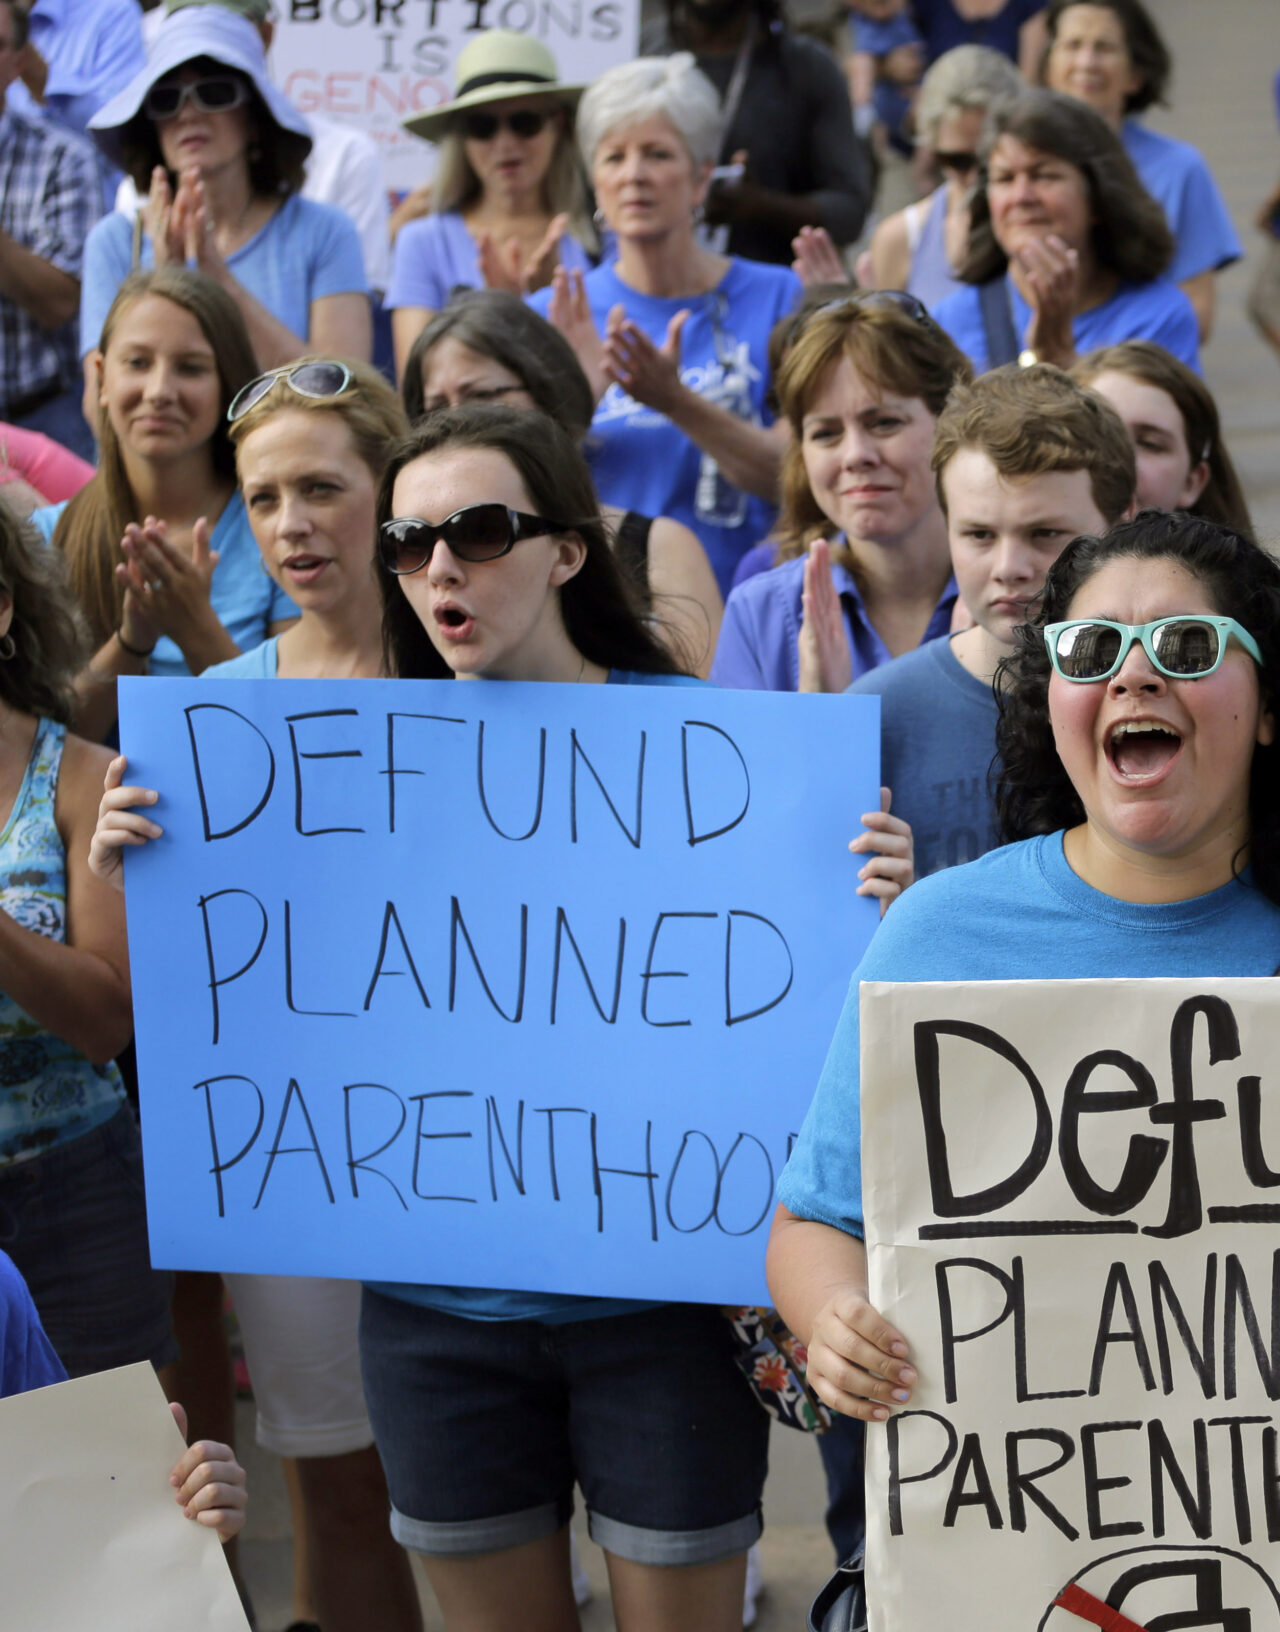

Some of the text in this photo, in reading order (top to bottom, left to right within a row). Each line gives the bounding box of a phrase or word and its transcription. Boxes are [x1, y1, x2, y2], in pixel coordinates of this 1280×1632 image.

[272, 0, 623, 41] BORTIONS
[376, 34, 449, 76] IS
[184, 703, 751, 848] DEFUND
[197, 888, 794, 1045] PLANNED
[193, 1074, 799, 1241] PARENTHOO
